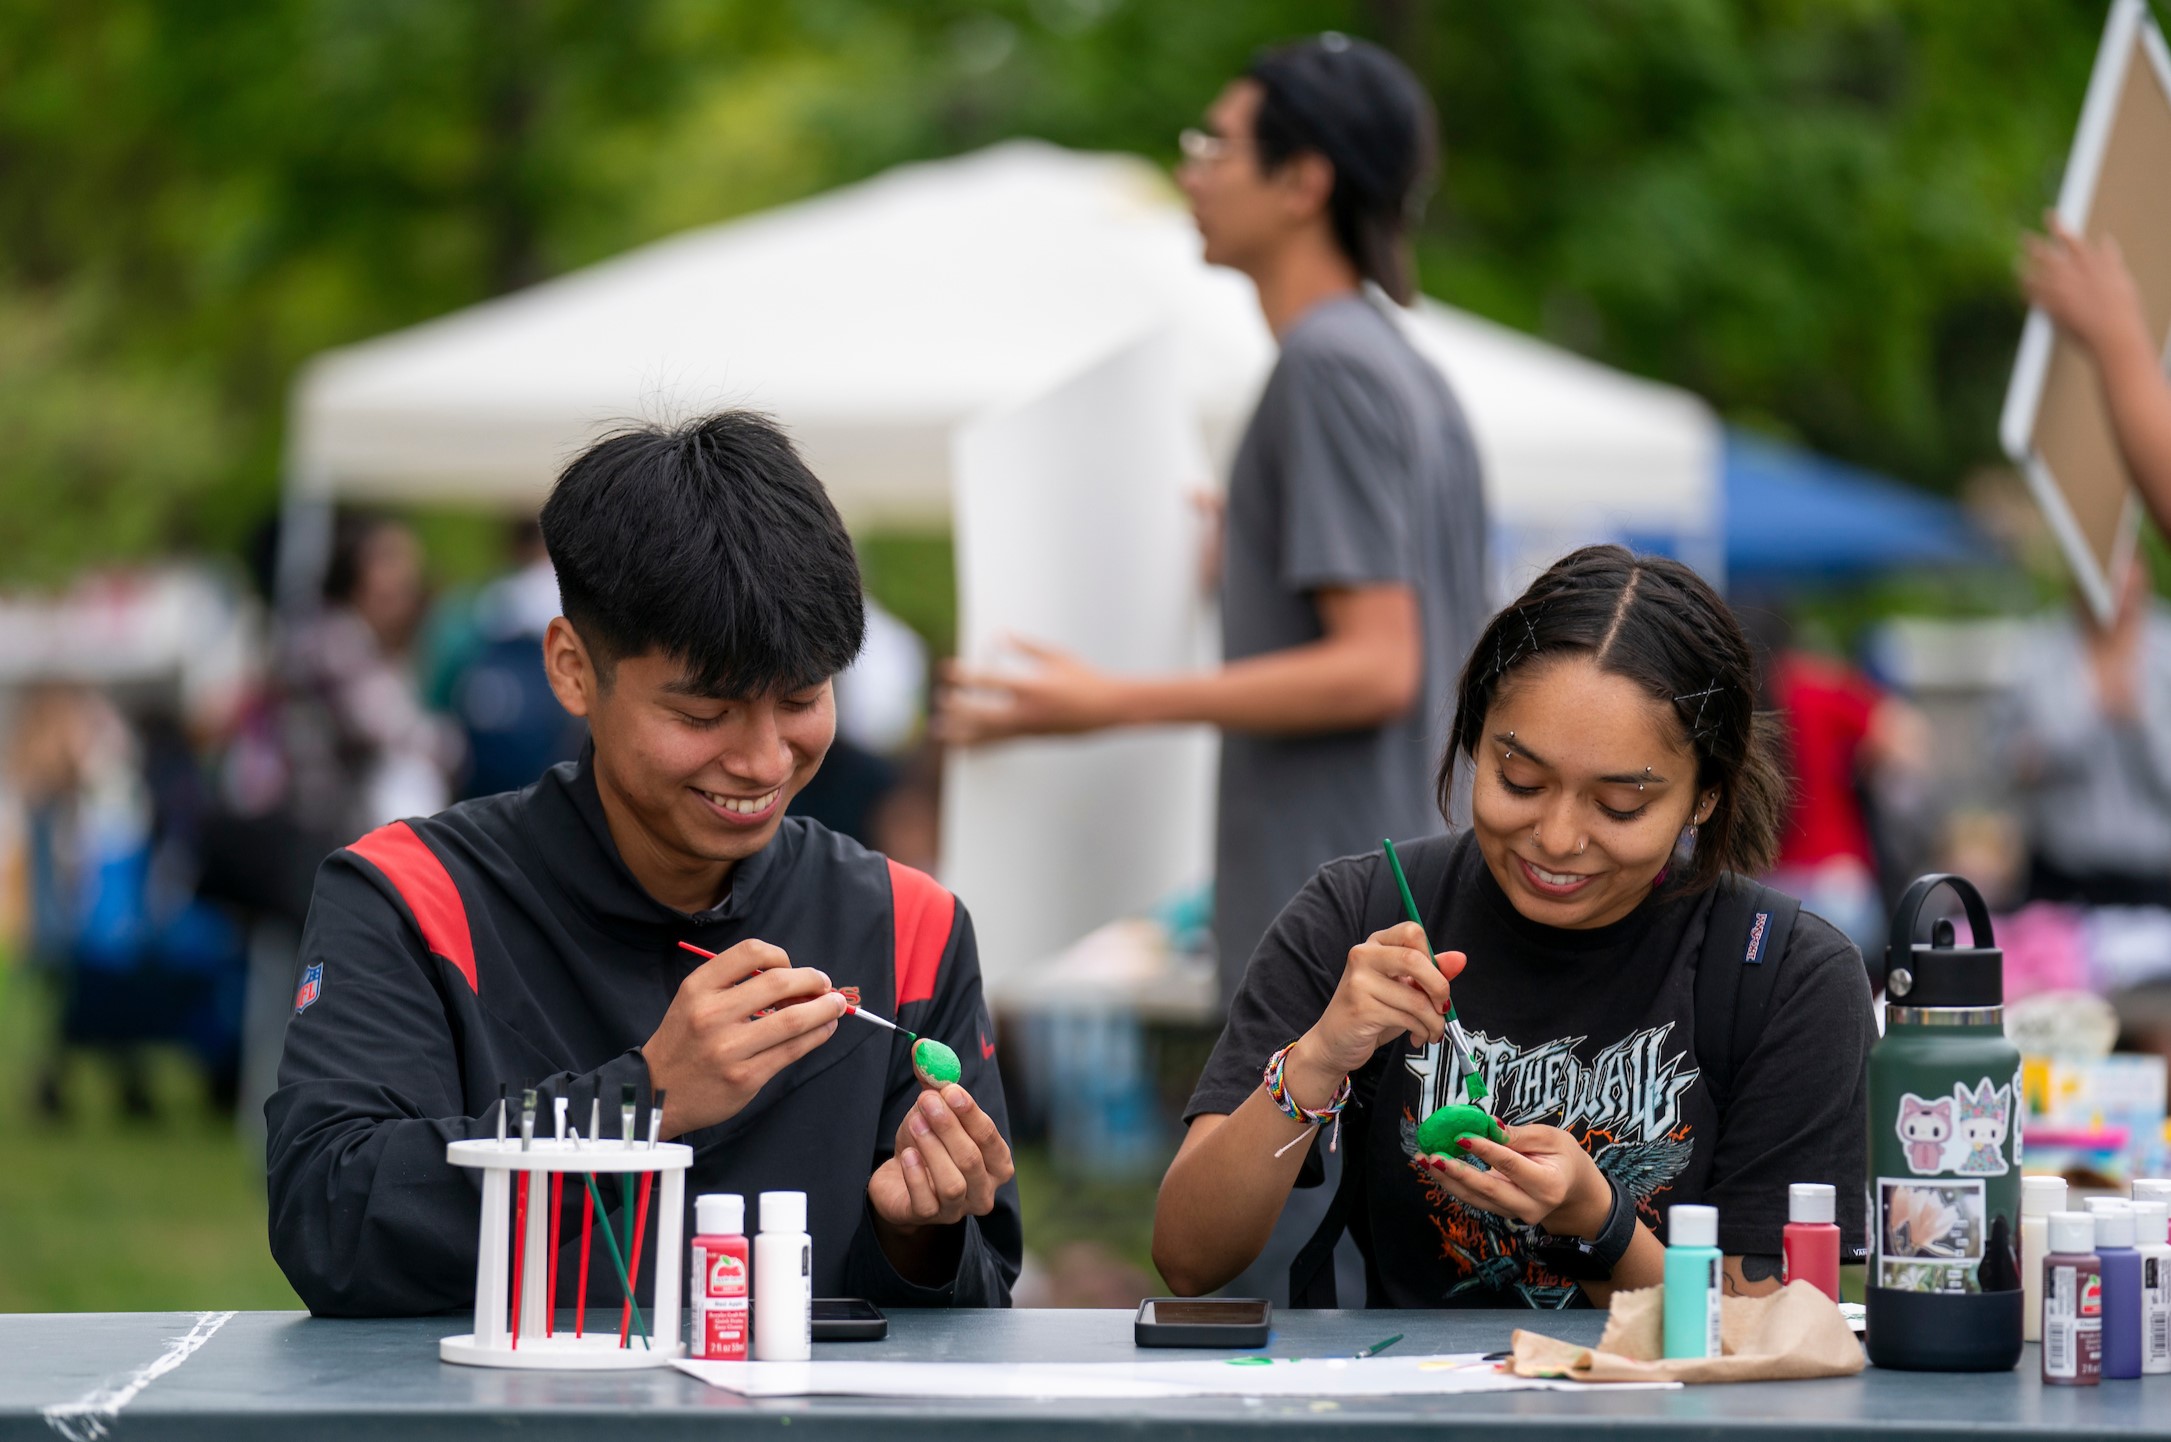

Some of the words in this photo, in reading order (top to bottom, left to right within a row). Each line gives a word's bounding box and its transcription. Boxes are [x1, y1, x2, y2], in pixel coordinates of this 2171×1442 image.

[1498, 1035, 1588, 1127] THE
[1559, 1020, 1700, 1143] WALL
[711, 1342, 716, 1352] 2
